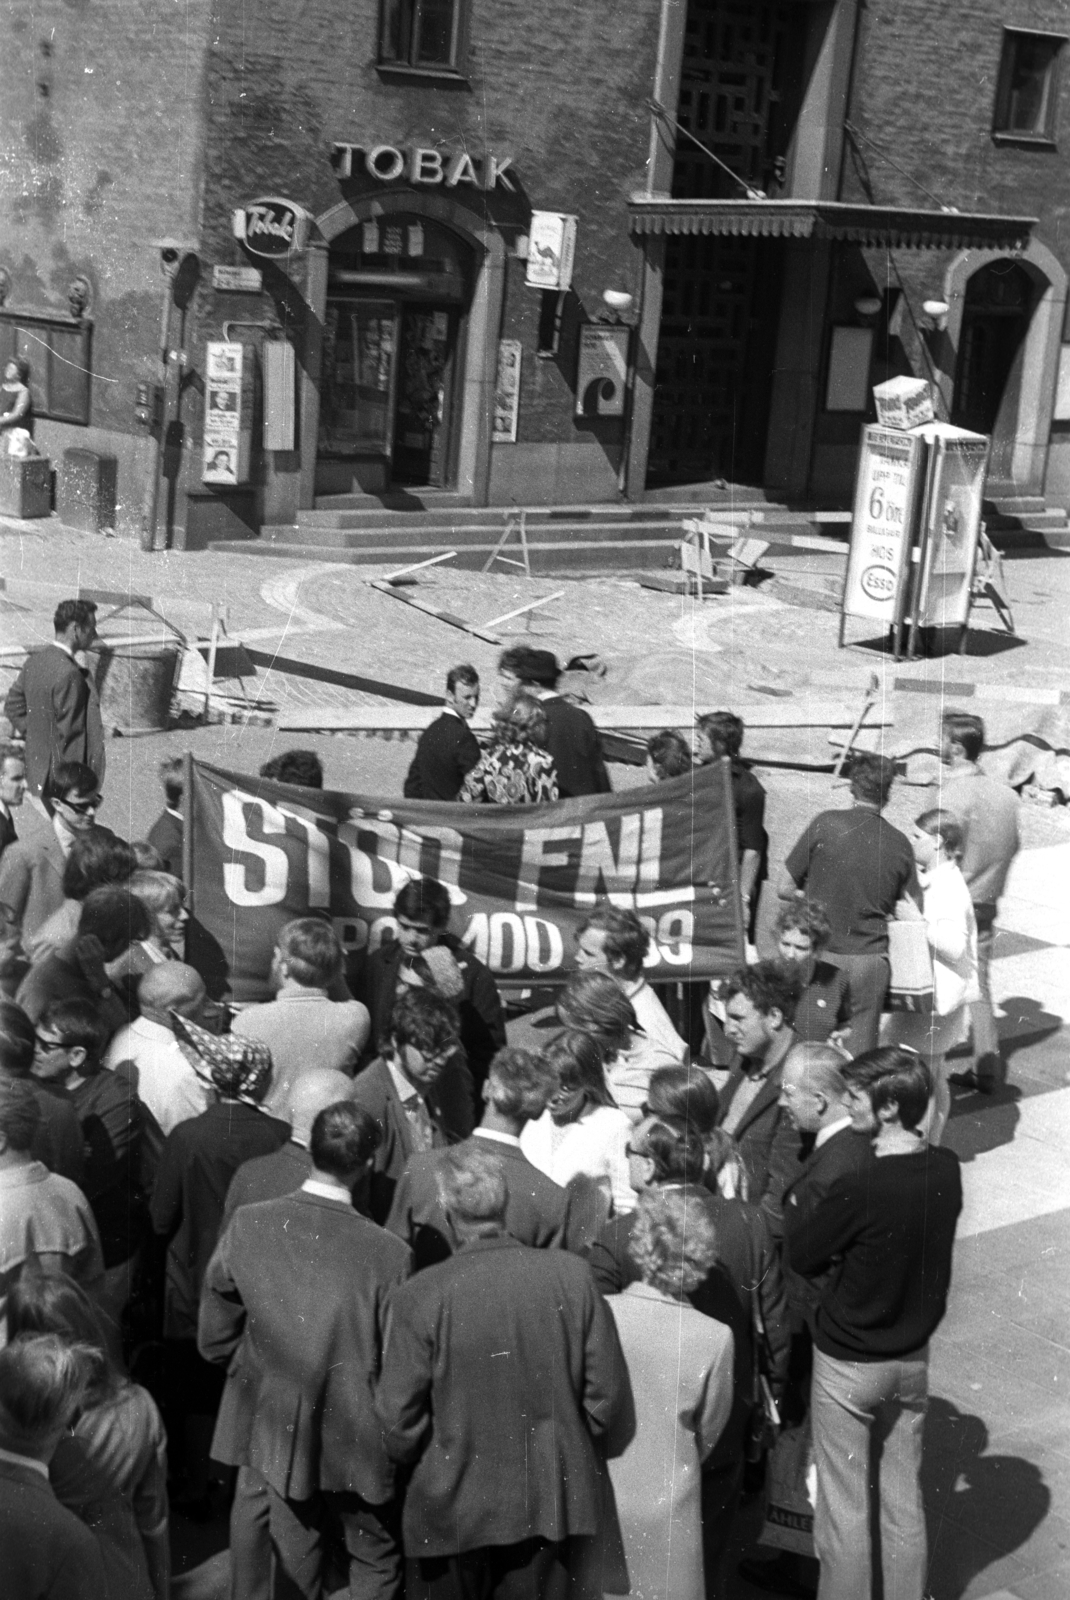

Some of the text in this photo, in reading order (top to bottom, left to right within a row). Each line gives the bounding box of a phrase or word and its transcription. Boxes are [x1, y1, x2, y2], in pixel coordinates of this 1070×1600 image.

[333, 141, 517, 193] TOBAK
[246, 204, 293, 243] Tobak
[869, 486, 885, 520] 6
[514, 807, 696, 912] FNL
